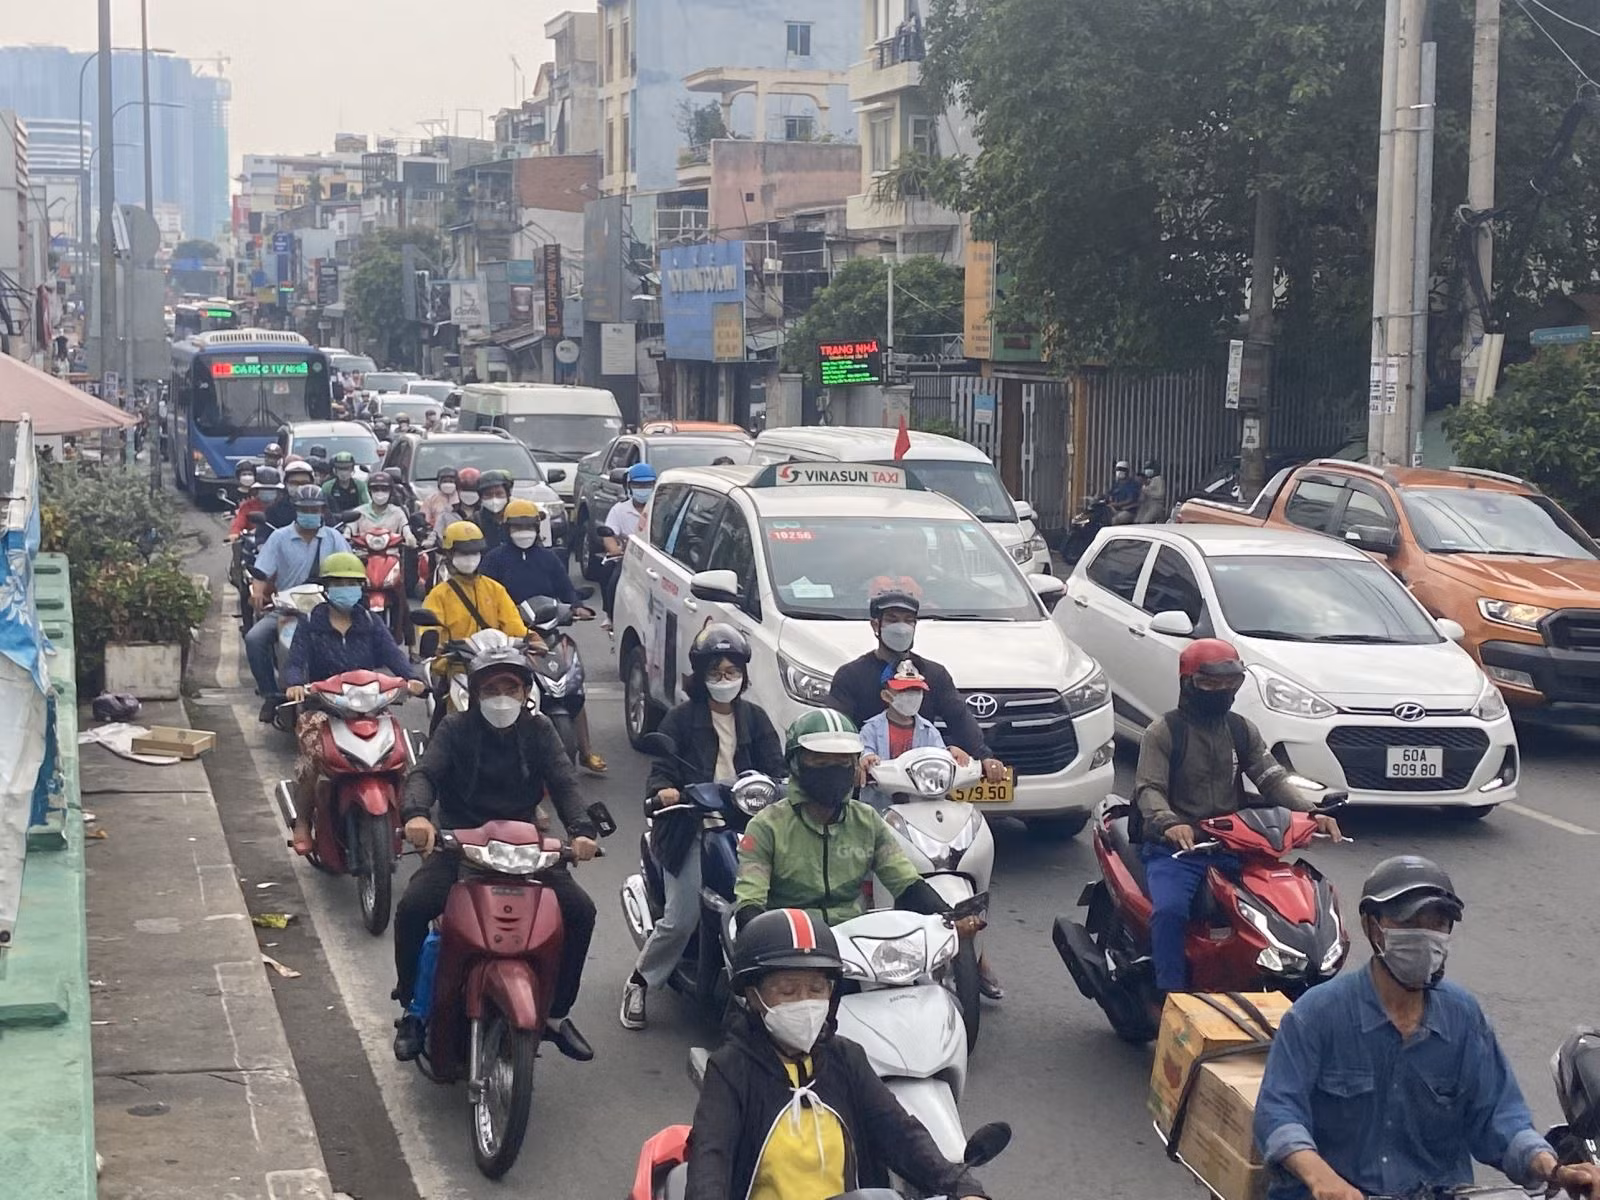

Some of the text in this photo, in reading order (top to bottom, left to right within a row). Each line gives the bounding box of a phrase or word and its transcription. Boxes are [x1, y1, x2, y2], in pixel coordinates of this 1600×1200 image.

[820, 345, 854, 356] TRANG
[805, 470, 899, 484] VINASUN TAXI
[1403, 749, 1426, 762] 60A
[1392, 763, 1436, 776] 909.80
